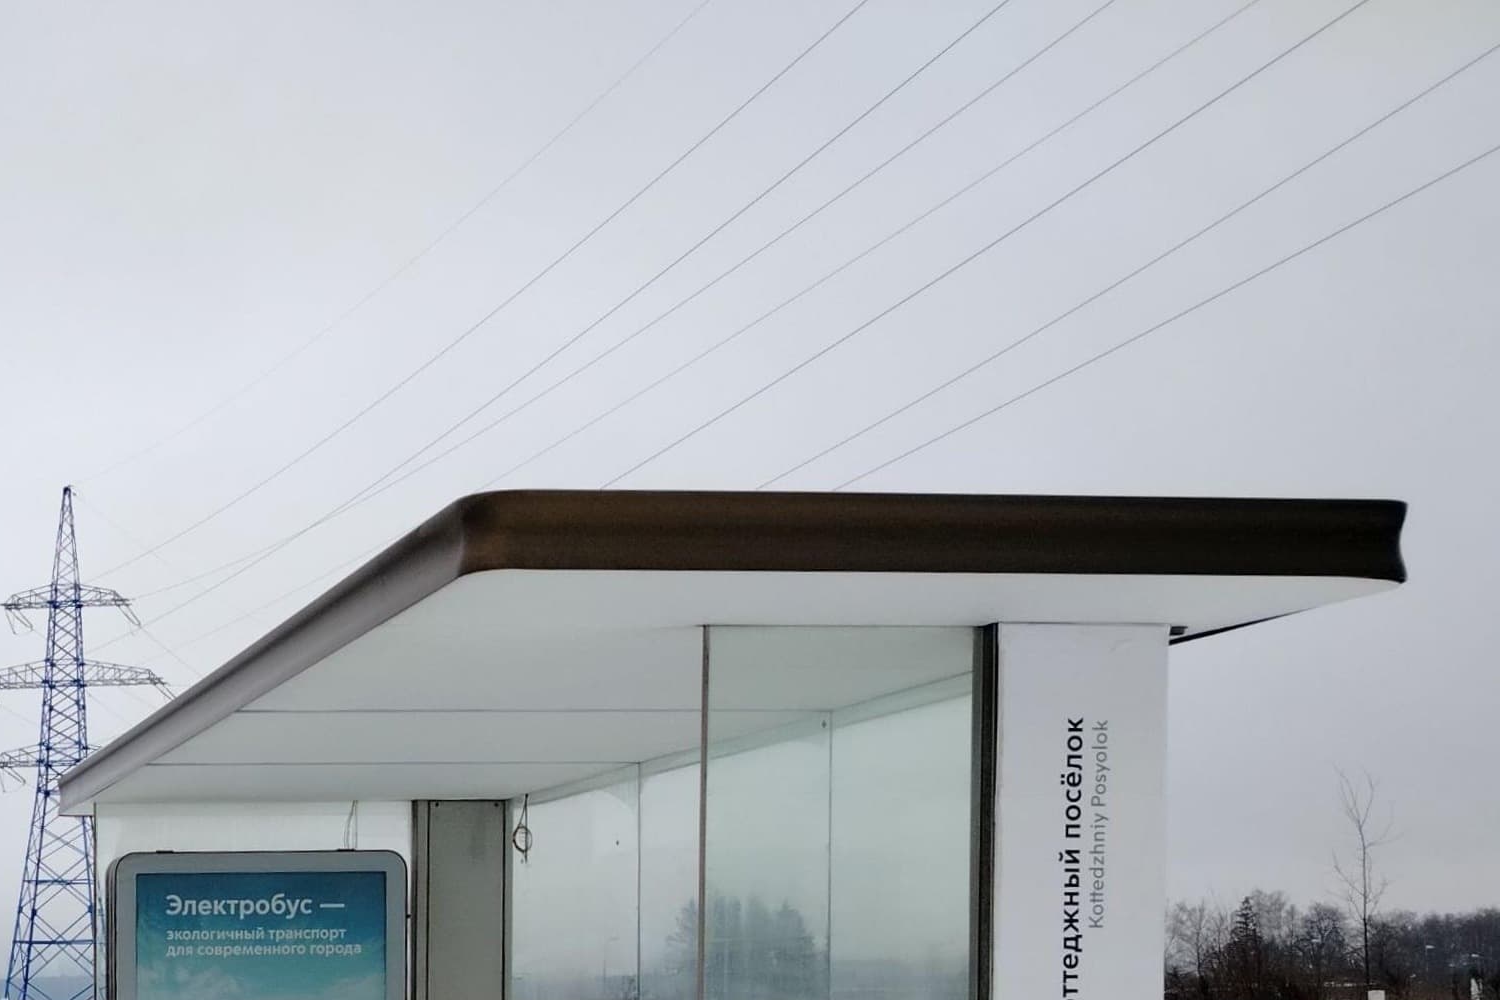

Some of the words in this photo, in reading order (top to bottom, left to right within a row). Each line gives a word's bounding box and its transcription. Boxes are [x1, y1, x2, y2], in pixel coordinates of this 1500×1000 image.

[1060, 717, 1084, 838] посёлок
[1091, 719, 1109, 808] Posyolok
[1088, 813, 1109, 929] Kottedzhniy
[165, 893, 313, 920] Электробус
[165, 926, 265, 941] экологичный
[268, 928, 347, 942] транспорт
[165, 945, 194, 958] для
[197, 944, 305, 958] современного
[310, 943, 362, 957] города
